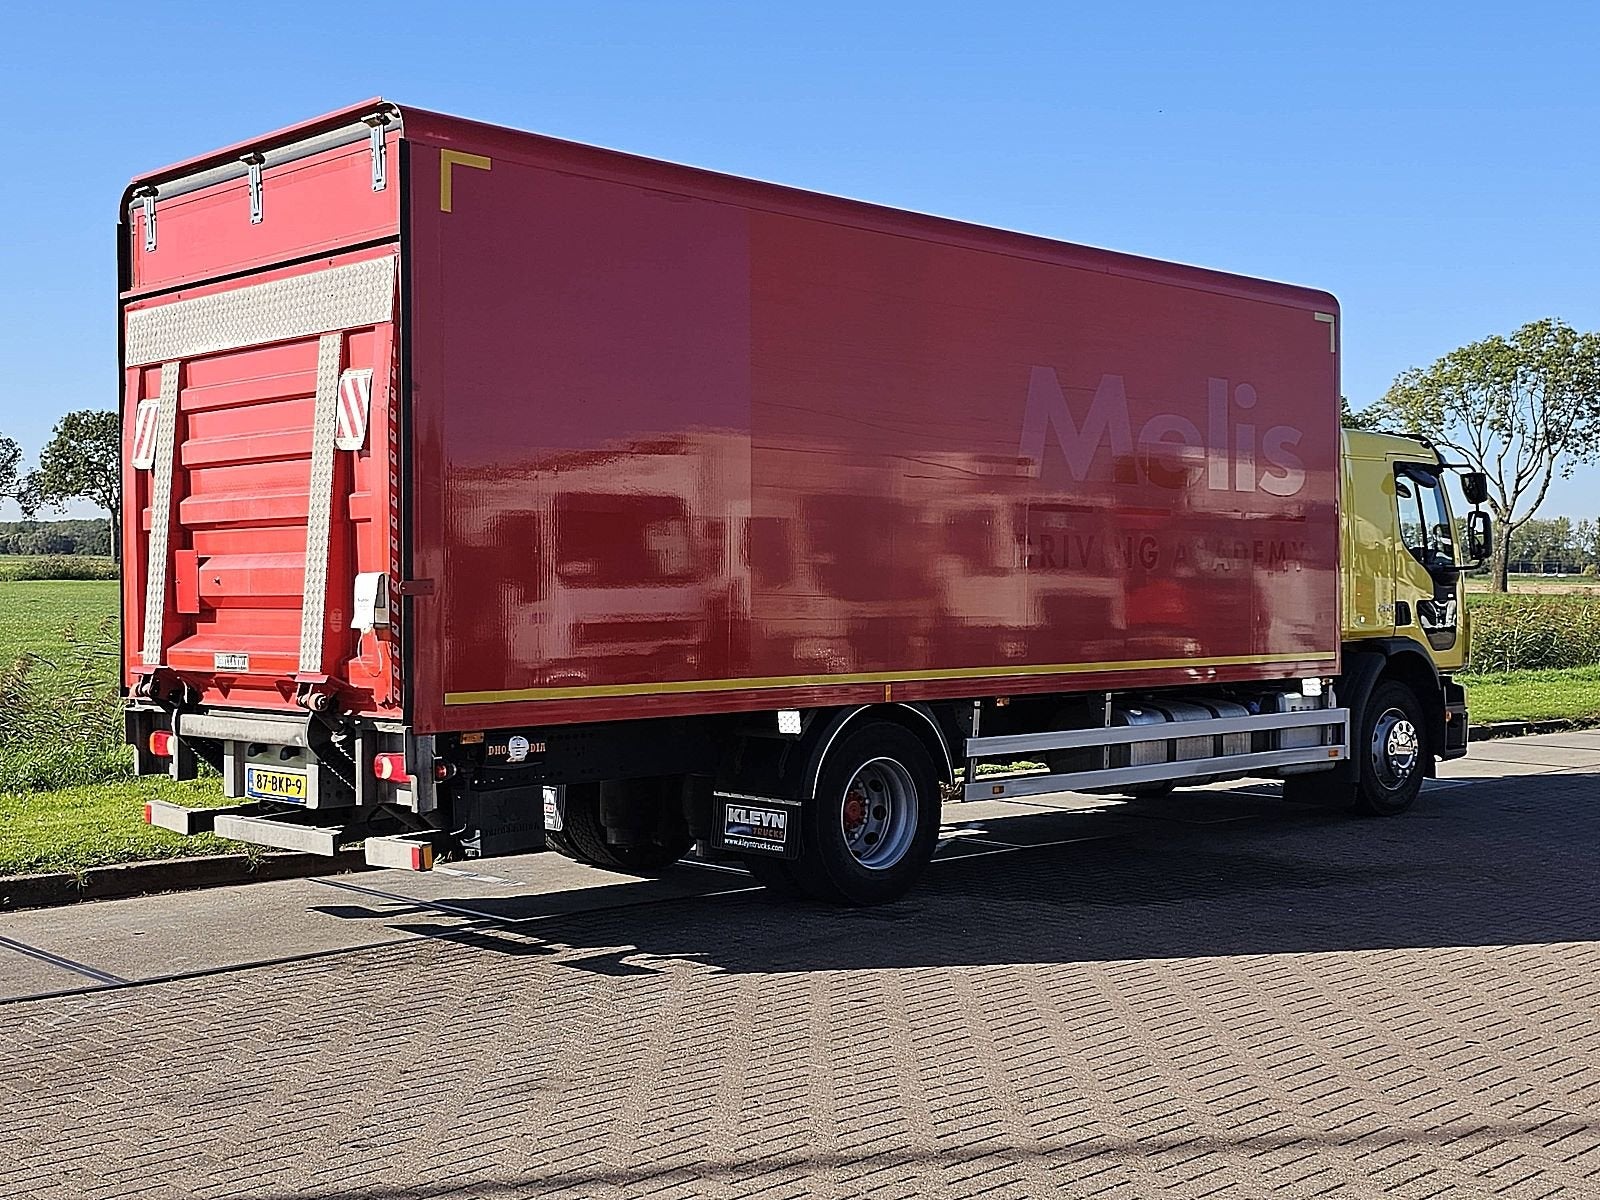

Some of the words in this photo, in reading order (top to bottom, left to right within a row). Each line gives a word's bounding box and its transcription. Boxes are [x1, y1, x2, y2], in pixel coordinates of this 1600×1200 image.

[1018, 365, 1307, 497] Melis
[1015, 535, 1158, 571] RIVNG
[256, 773, 302, 795] 87-BKP-9
[728, 807, 785, 829] KLEYN
[752, 827, 784, 839] TRUCKS
[724, 838, 784, 852] www.kleyntrucks.com
